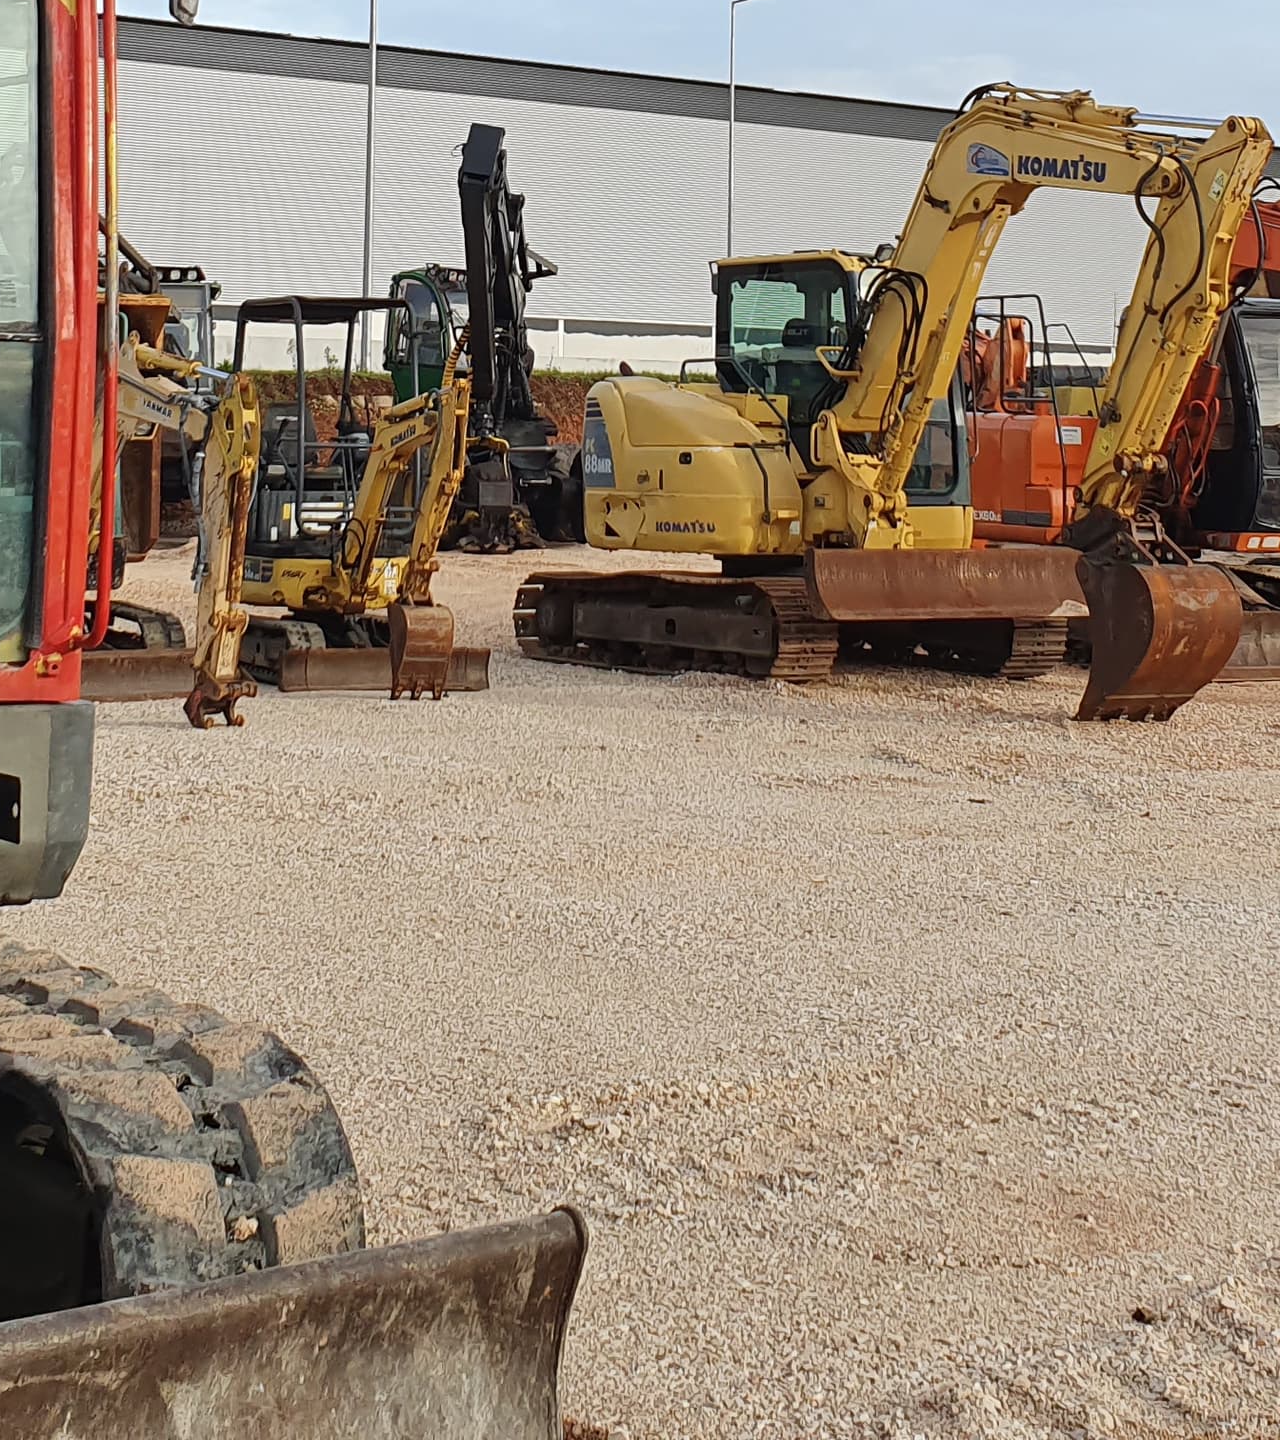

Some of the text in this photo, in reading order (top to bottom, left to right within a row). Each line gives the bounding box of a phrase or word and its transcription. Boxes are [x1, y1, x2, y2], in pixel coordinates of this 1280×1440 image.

[1017, 154, 1107, 183] KOMATSU
[143, 397, 173, 419] YANMAR
[656, 520, 716, 534] KOMATSU
